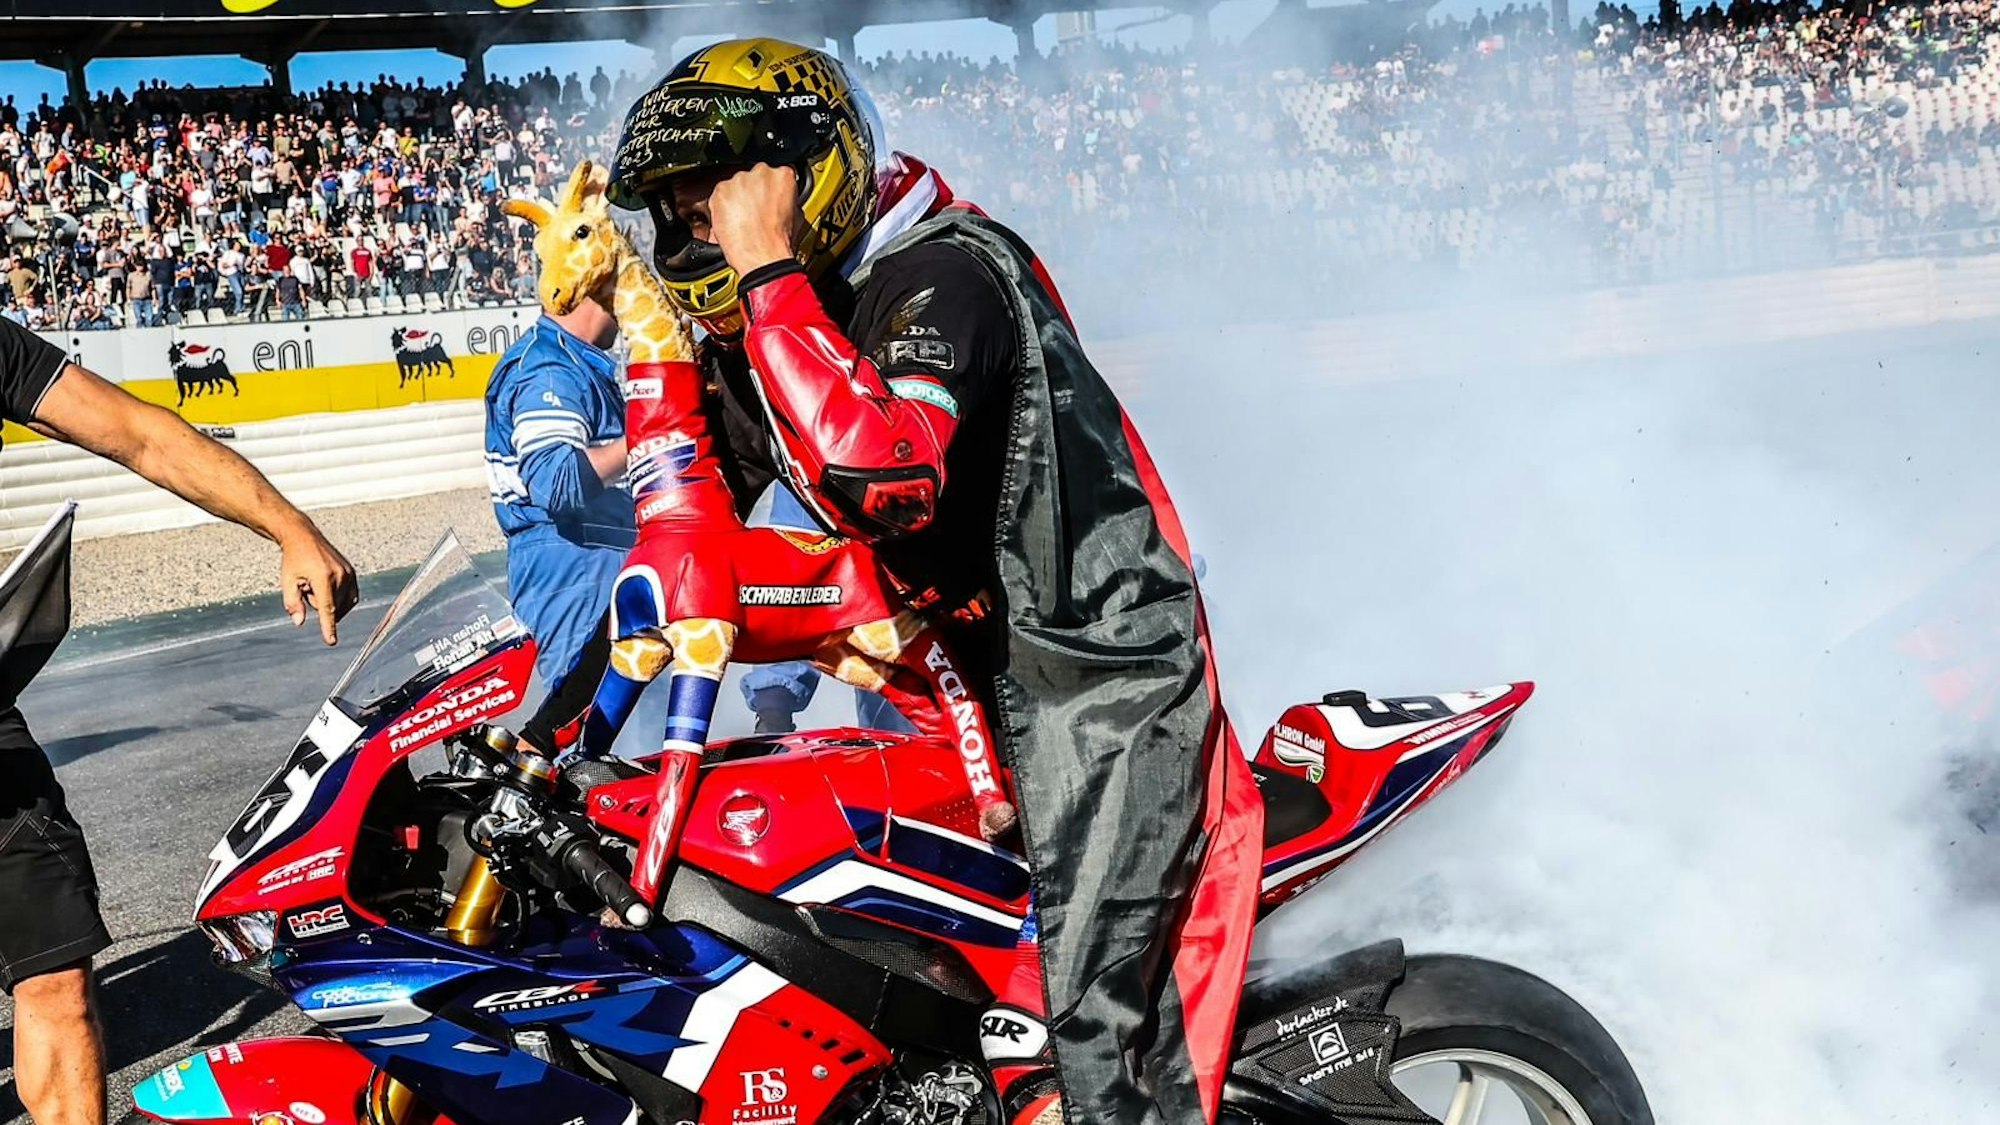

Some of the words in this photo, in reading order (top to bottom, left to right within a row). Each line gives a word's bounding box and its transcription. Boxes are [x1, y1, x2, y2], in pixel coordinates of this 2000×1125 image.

[643, 86, 671, 108] WIR
[776, 95, 818, 110] X-803
[253, 324, 314, 372] eni
[740, 586, 841, 605] SCHWABENLEDER
[387, 677, 509, 738] HONDA
[390, 716, 452, 753] Financial
[454, 690, 516, 722] Services
[925, 641, 999, 796] HONDA
[287, 904, 346, 934] HRC
[487, 993, 590, 1014] FIREBLADE
[1275, 996, 1349, 1036] derlacker.de
[733, 1104, 798, 1120] Facility
